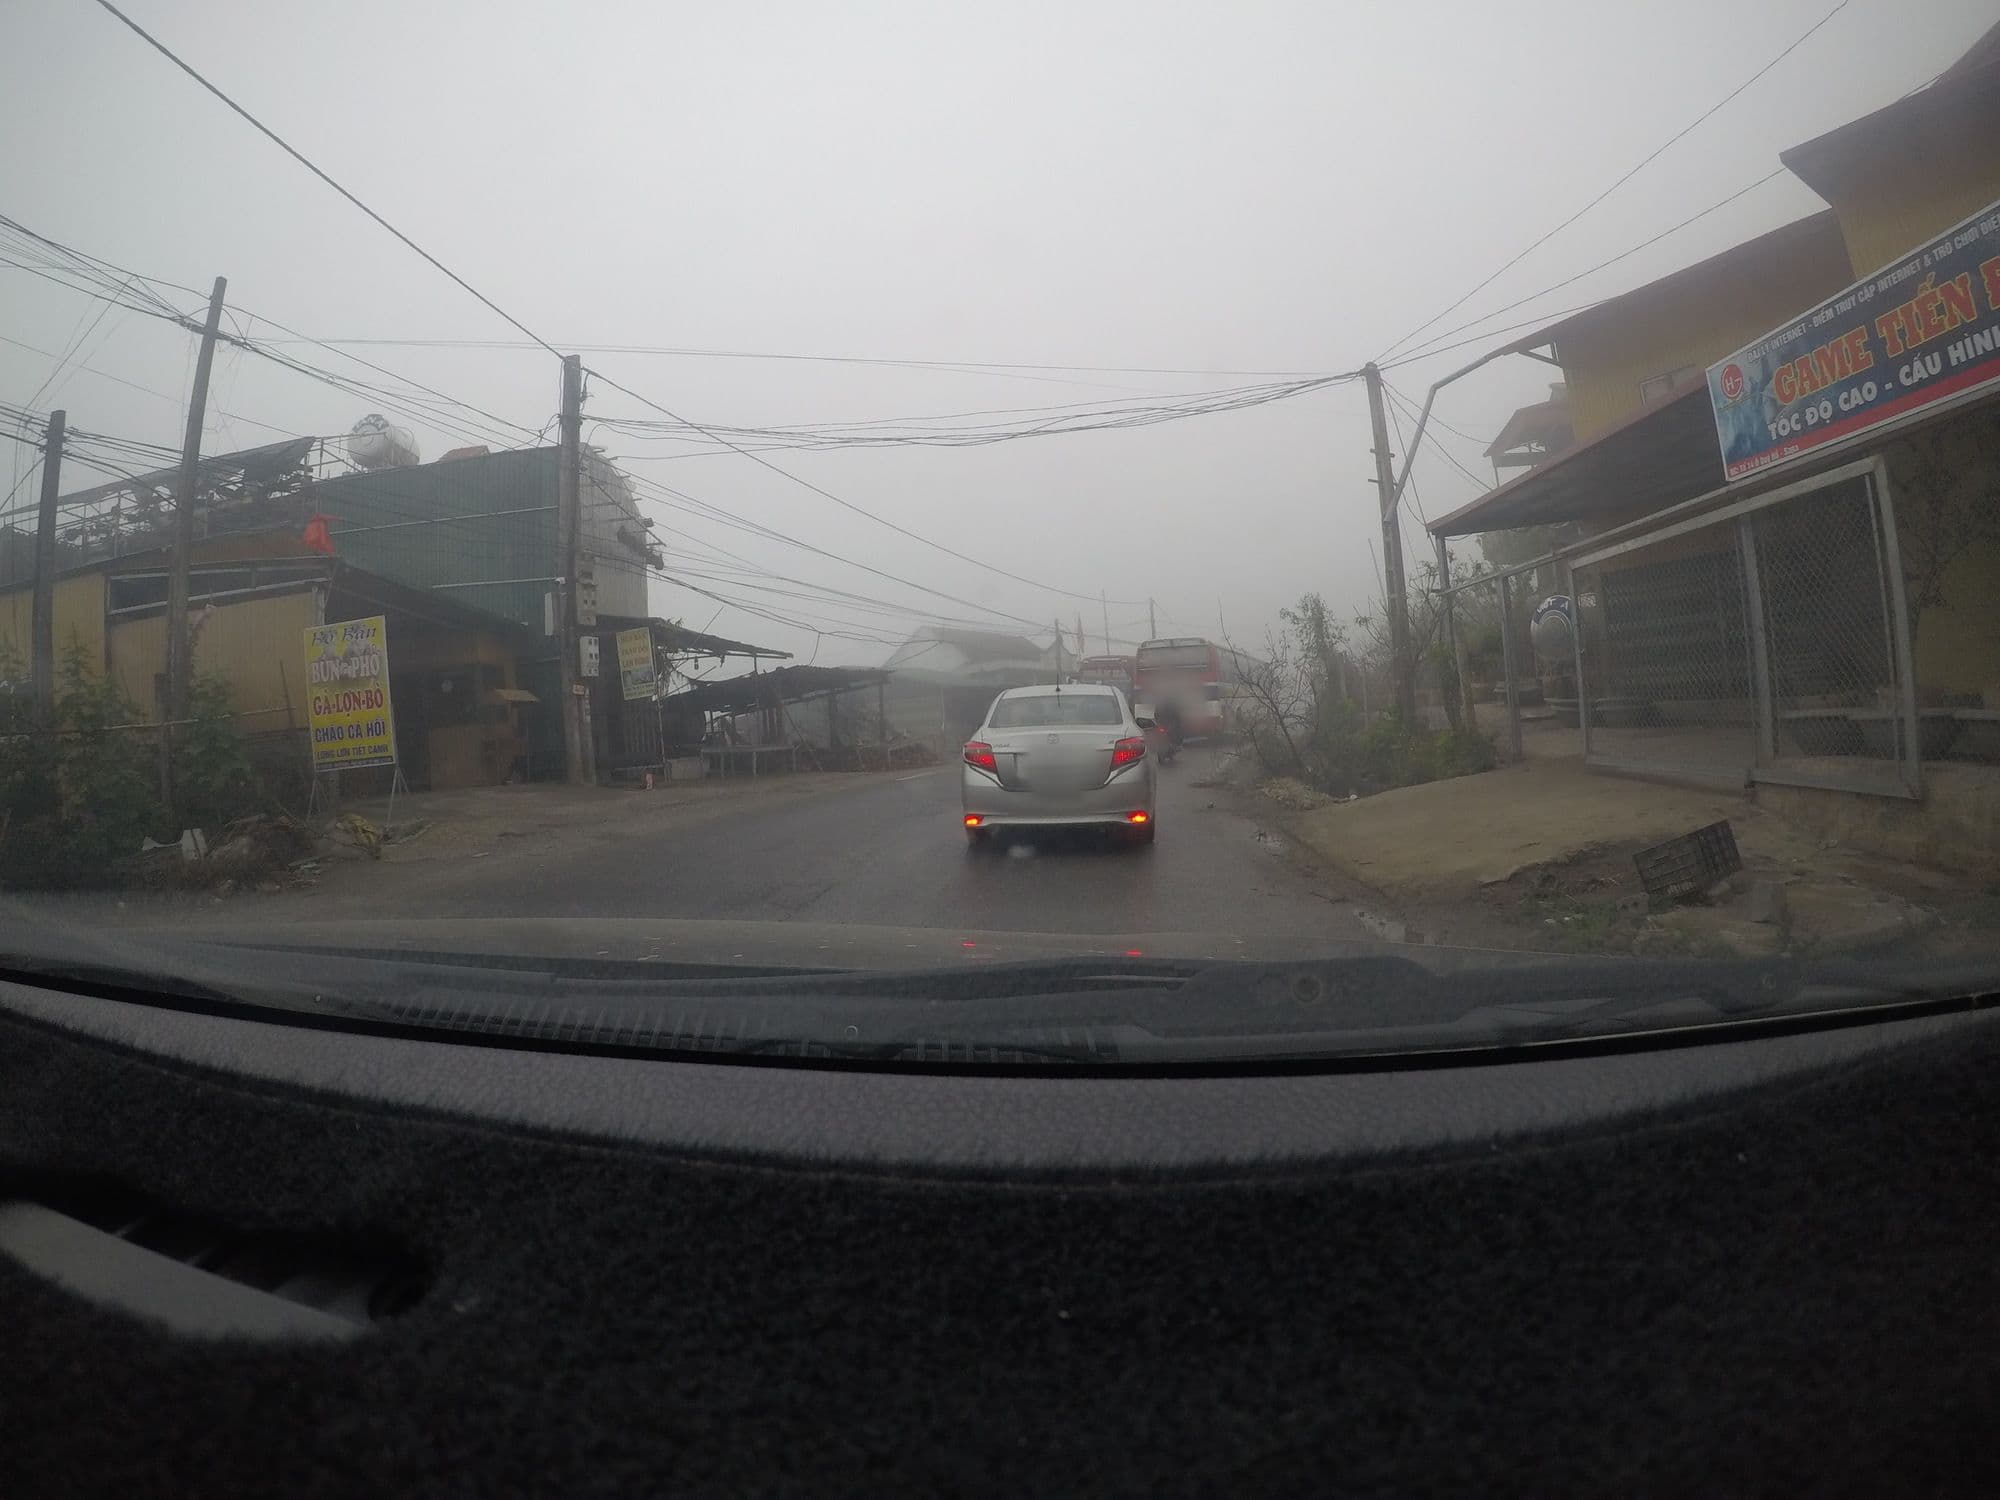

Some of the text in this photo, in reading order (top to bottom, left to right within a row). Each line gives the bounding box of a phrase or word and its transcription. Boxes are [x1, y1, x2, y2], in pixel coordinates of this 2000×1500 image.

[1772, 322, 1808, 351] INTERNET
[1835, 296, 1857, 315] TRUY
[1877, 258, 1921, 293] INTERNET
[1772, 326, 1874, 405] GAME
[1875, 271, 1977, 358] TIẾN
[1768, 407, 1802, 441] TỐC
[1805, 396, 1833, 424] ĐỘ
[1838, 381, 1878, 412] CAO
[1899, 352, 1942, 387] CẤU
